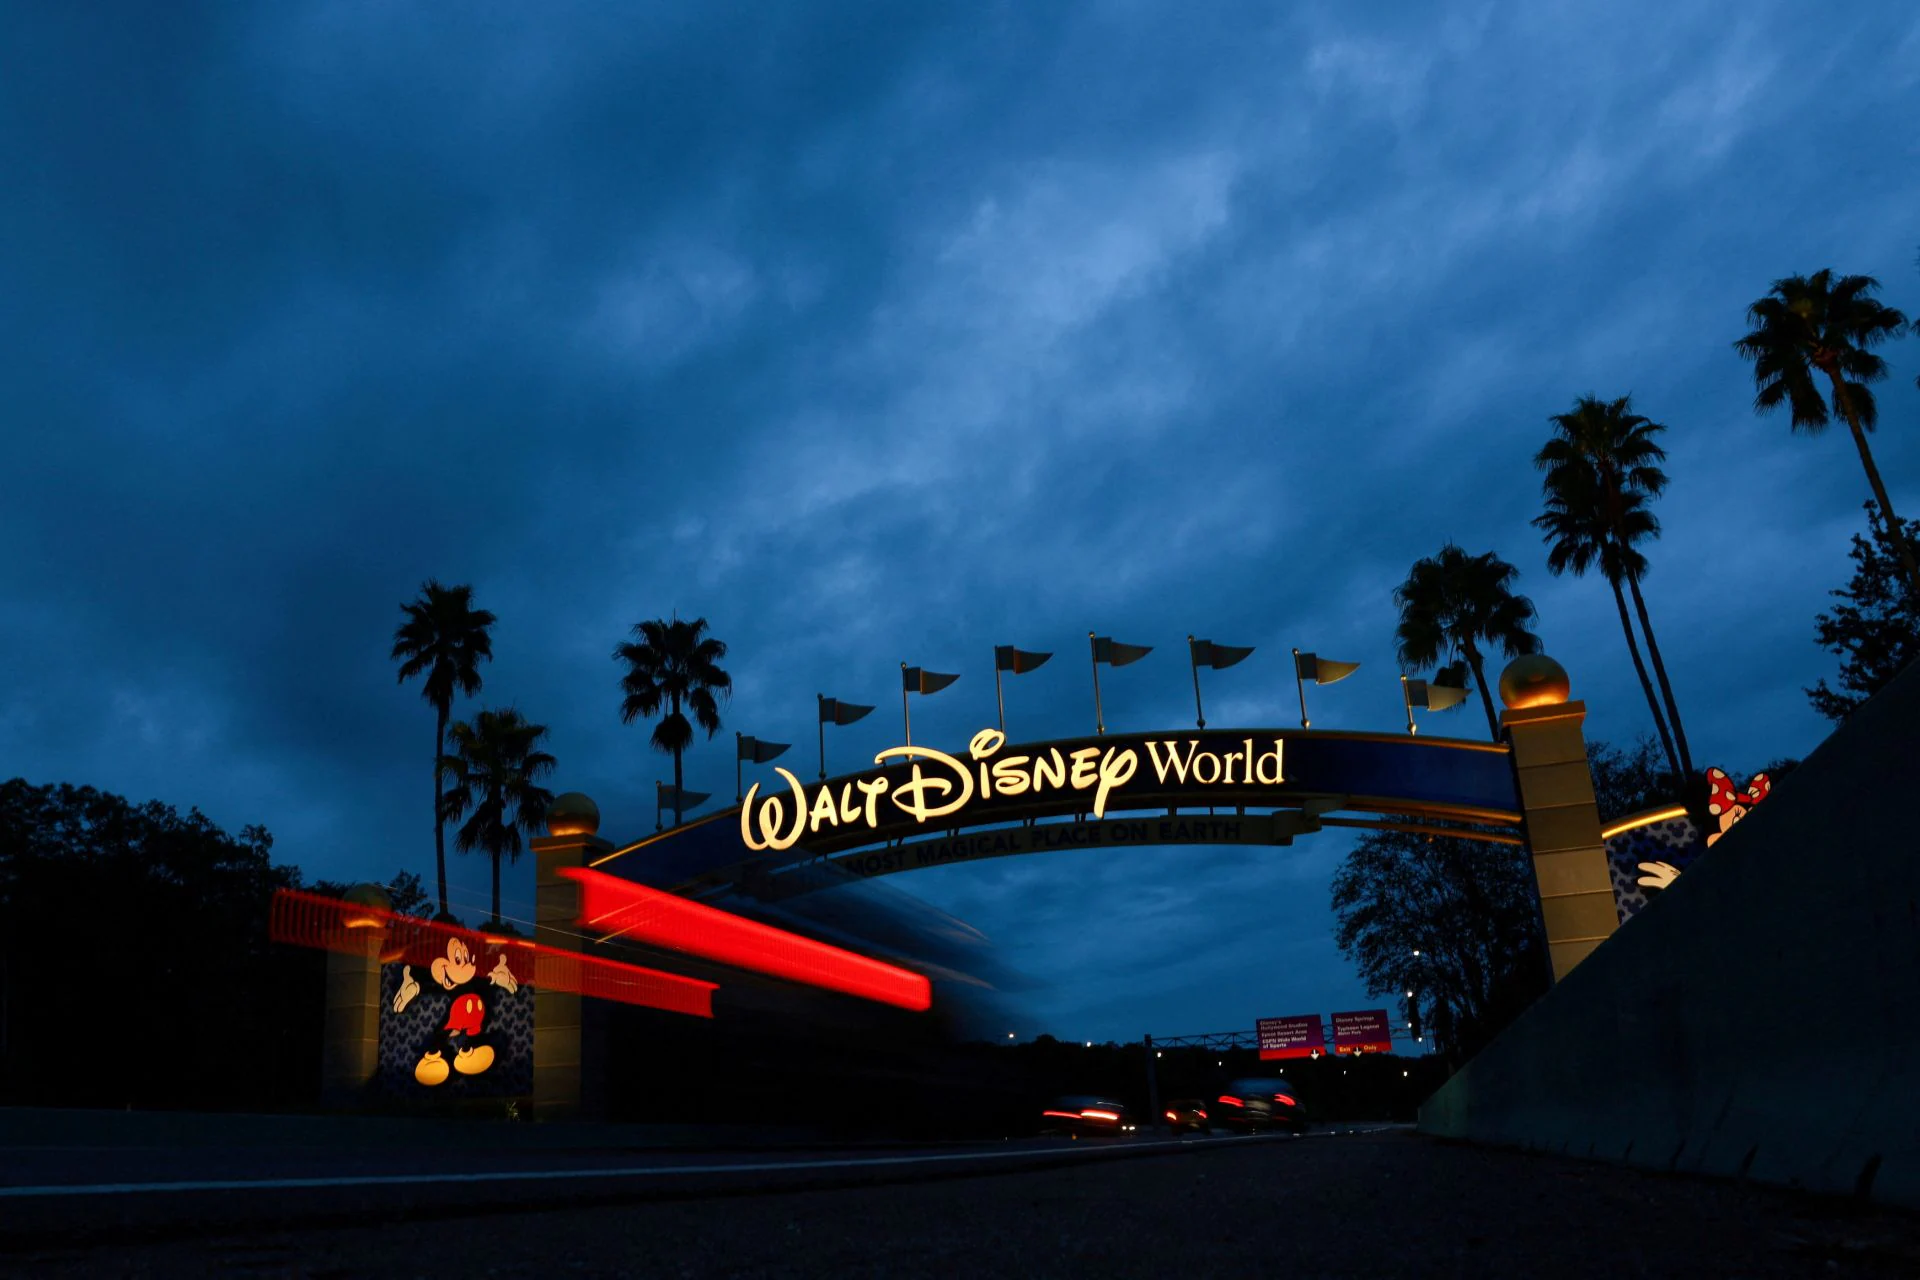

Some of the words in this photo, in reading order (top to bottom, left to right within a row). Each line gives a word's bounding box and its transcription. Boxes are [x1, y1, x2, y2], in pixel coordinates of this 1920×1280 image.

[1144, 738, 1284, 785] World
[916, 832, 1022, 865] MAGICAL
[1031, 825, 1101, 848] PLACE
[1110, 822, 1148, 841] ON
[1159, 820, 1242, 841] EARTH
